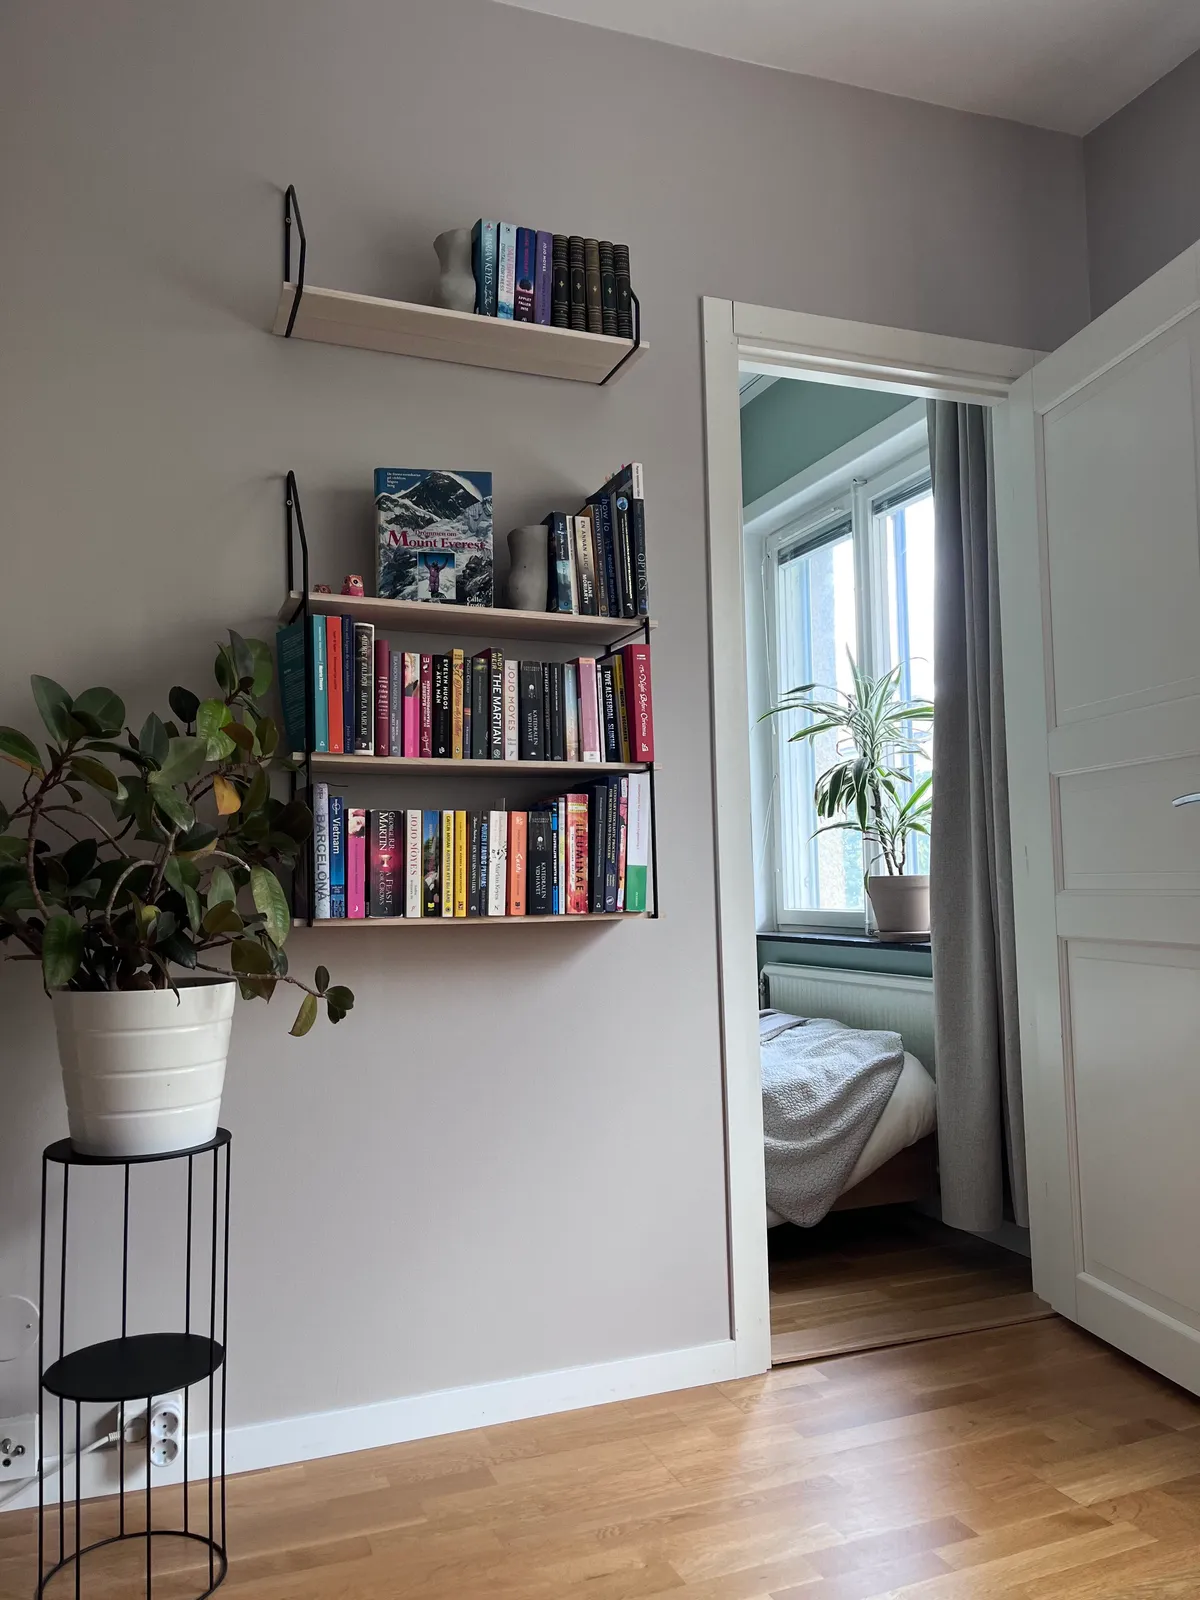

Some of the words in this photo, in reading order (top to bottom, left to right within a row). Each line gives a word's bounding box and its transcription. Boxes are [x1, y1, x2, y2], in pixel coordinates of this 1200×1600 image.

[485, 232, 493, 261] MARIAN
[506, 263, 514, 294] BROWN
[602, 498, 610, 519] how
[415, 529, 446, 537] Drömmen
[580, 520, 586, 529] EN
[603, 522, 610, 532] to
[387, 530, 438, 547] Mount
[442, 538, 485, 549] Everest
[637, 552, 647, 591] OPTICS
[492, 673, 502, 694] THE
[508, 665, 516, 692] JOJO
[637, 673, 646, 692] Night
[508, 696, 516, 731] MOYES
[605, 686, 613, 720] ALSTERDAL
[638, 693, 648, 712] Before
[492, 696, 502, 744] MARTIAN
[640, 712, 649, 737] Christmas
[333, 817, 341, 854] Vietnam
[379, 812, 389, 851] MARTIN
[316, 814, 328, 902] BARCELONA
[410, 842, 419, 876] MOYES
[515, 853, 523, 873] Sushi
[576, 823, 584, 891] ILLUMINAE
[386, 879, 394, 905] FEAST
